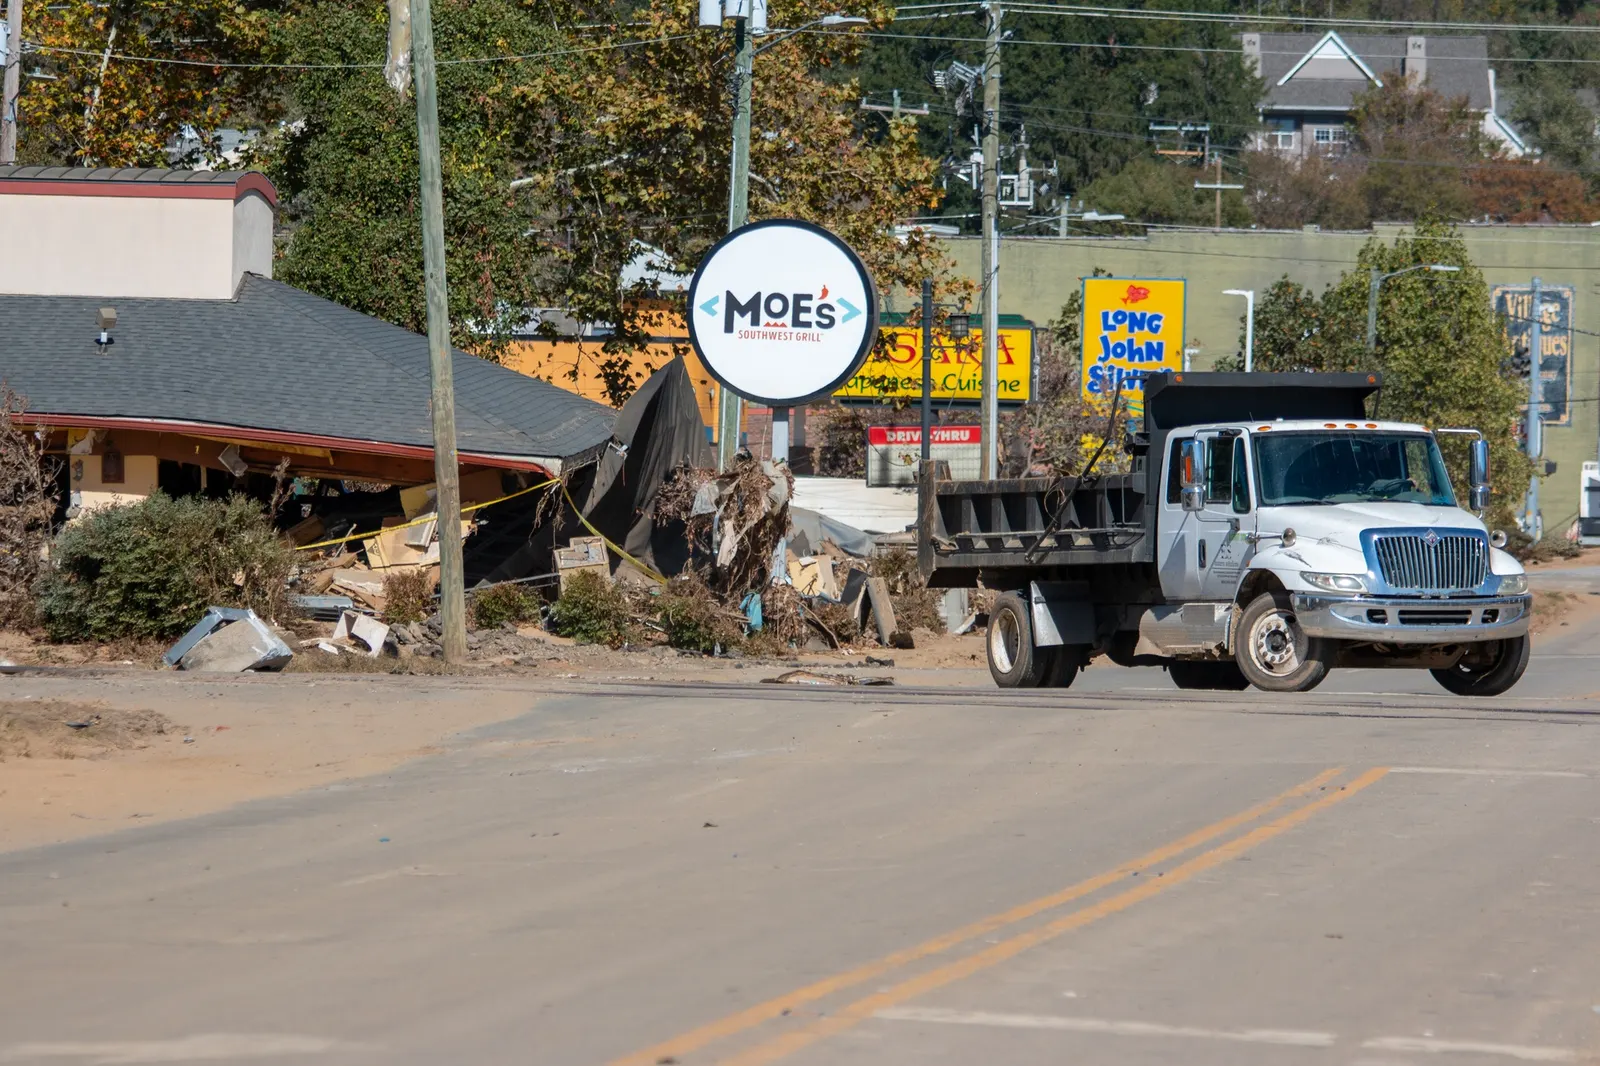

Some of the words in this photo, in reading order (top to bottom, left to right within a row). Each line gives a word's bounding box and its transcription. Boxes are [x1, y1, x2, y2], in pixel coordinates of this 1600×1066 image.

[1101, 309, 1164, 334] LONG
[738, 329, 793, 341] SOUTHWEST
[795, 332, 821, 342] GRILL
